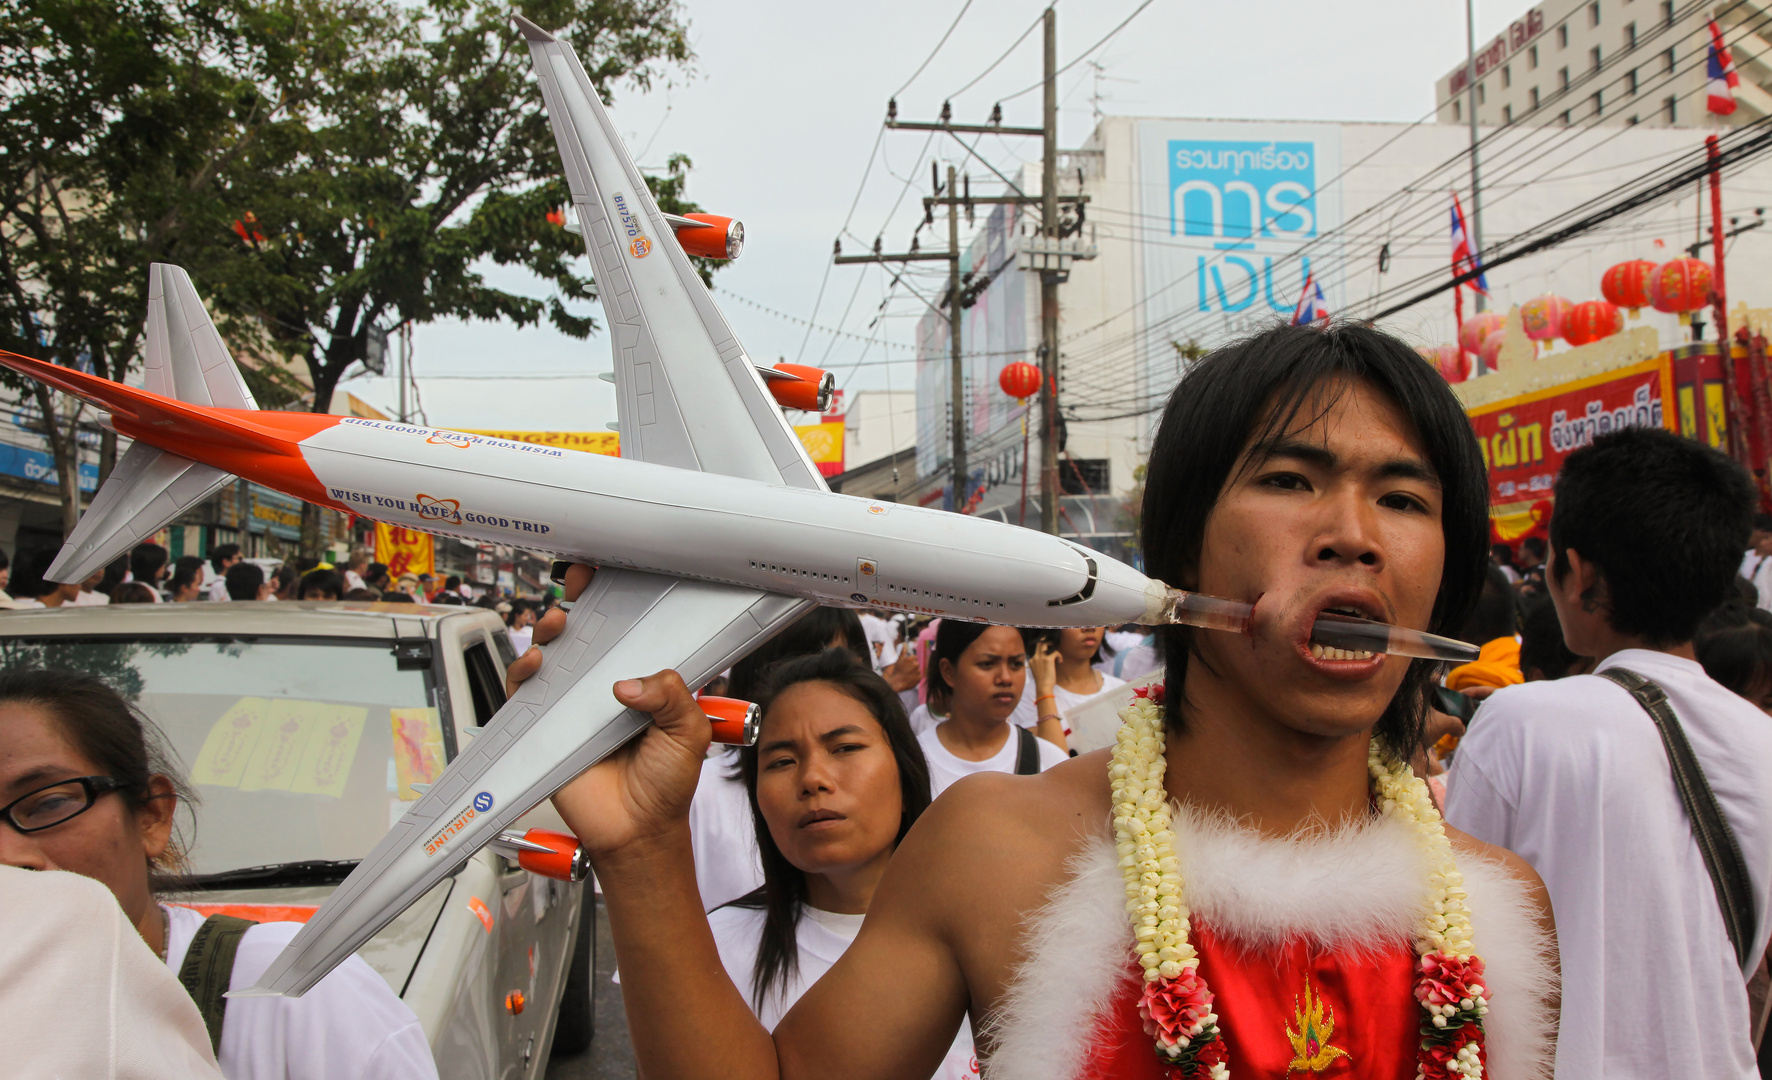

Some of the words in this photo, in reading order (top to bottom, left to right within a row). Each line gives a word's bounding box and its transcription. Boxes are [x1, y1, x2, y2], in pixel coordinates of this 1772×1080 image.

[1176, 142, 1310, 175] รวมทุกเรื่อง
[614, 195, 637, 237] BH7570
[1173, 180, 1315, 238] การ
[635, 240, 646, 256] AIR
[1197, 242, 1310, 313] เงิน
[345, 417, 381, 429] TRIP
[385, 424, 427, 436] GOOD
[1549, 383, 1663, 453] จังหวัดภเก็ต
[443, 432, 483, 444] HAVE
[485, 438, 517, 451] YOU
[522, 445, 563, 458] WISH
[330, 488, 373, 505] WISH
[374, 495, 406, 511] YOU
[409, 502, 449, 518] HAVE
[452, 510, 463, 521] A
[465, 513, 509, 528] GOOD
[512, 519, 551, 535] TRIP
[870, 598, 946, 614] AIRLINE
[425, 808, 476, 855] AIRLINE
